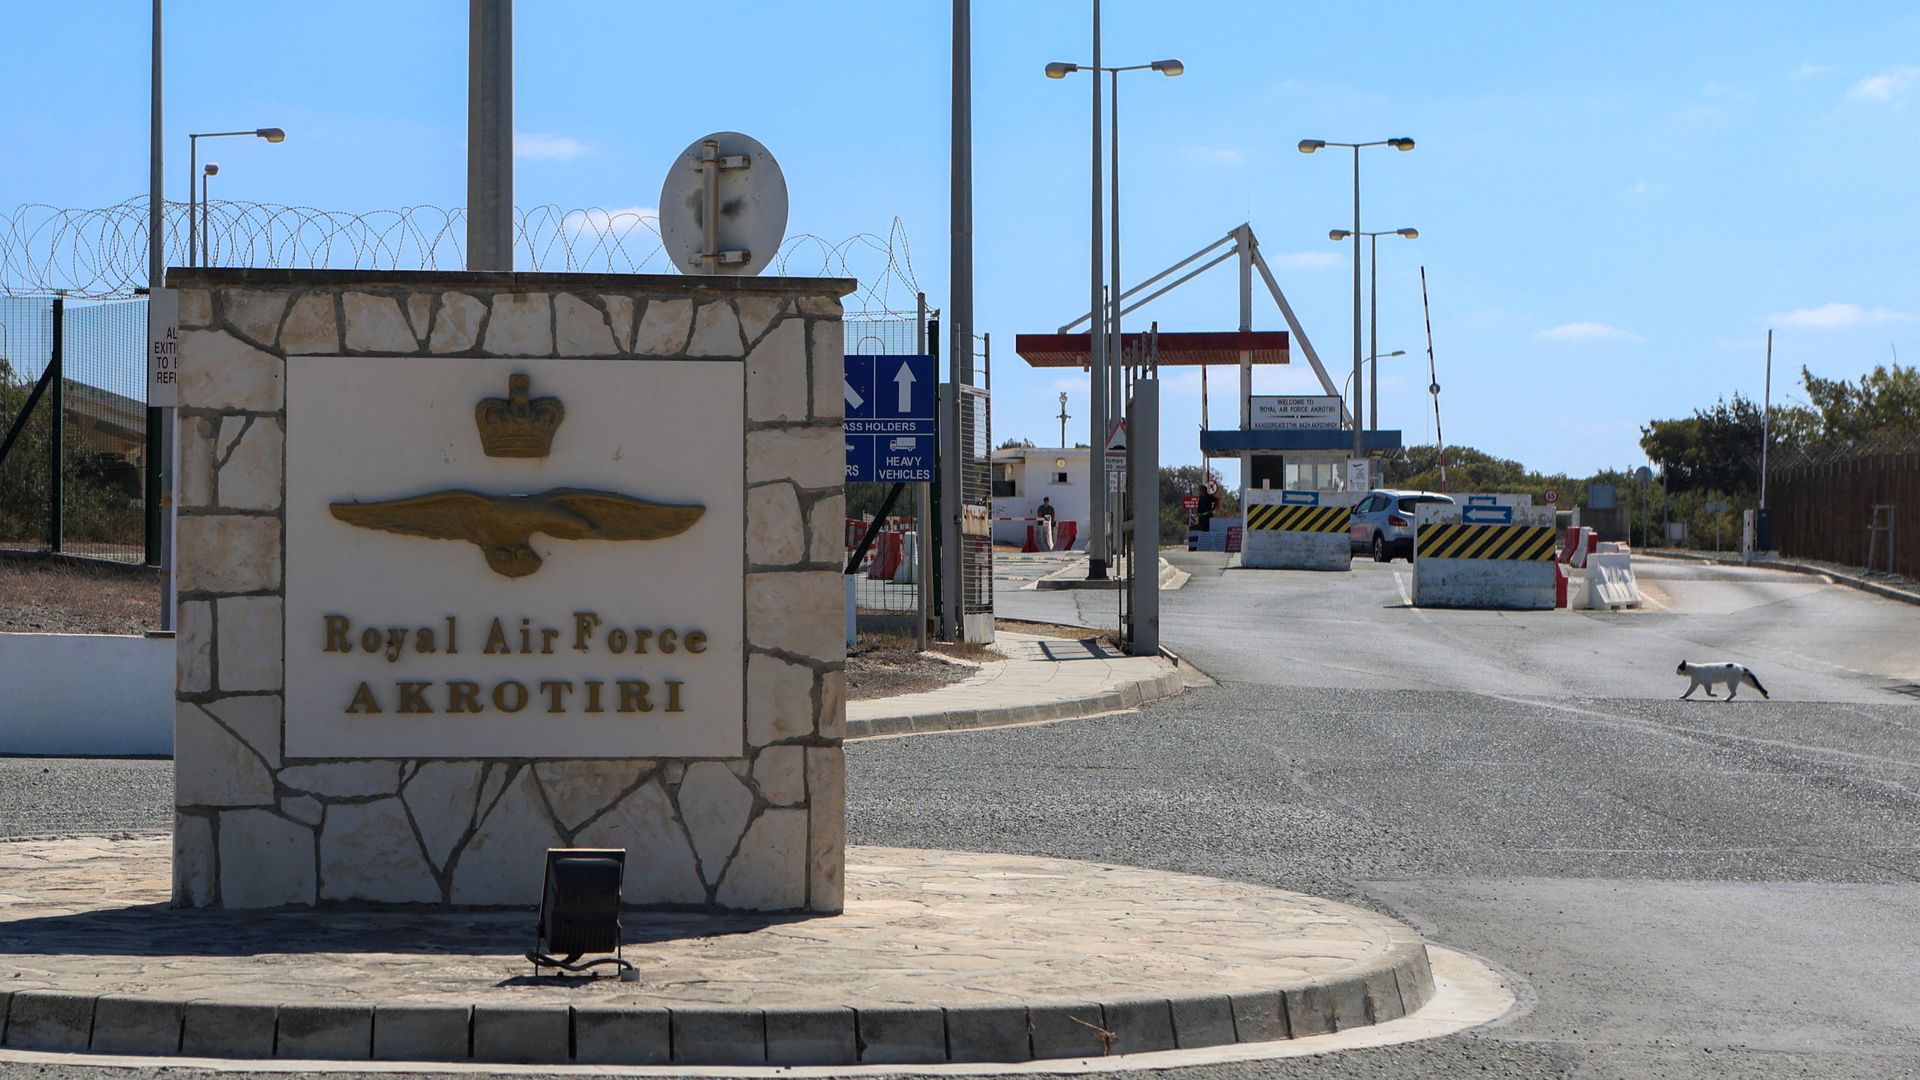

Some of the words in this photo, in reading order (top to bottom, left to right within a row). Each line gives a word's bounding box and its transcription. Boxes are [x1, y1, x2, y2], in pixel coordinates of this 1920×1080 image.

[166, 326, 178, 340] AL
[154, 341, 178, 354] EXITI
[156, 356, 169, 369] TO
[843, 422, 863, 431] ASS
[865, 422, 917, 431] HOLDERS
[886, 456, 922, 467] HEAVY
[879, 469, 931, 480] VEHICLES
[323, 614, 458, 663] Royal
[483, 617, 560, 655] Air
[573, 612, 708, 655] Force
[344, 681, 685, 714] AKROTIRI
